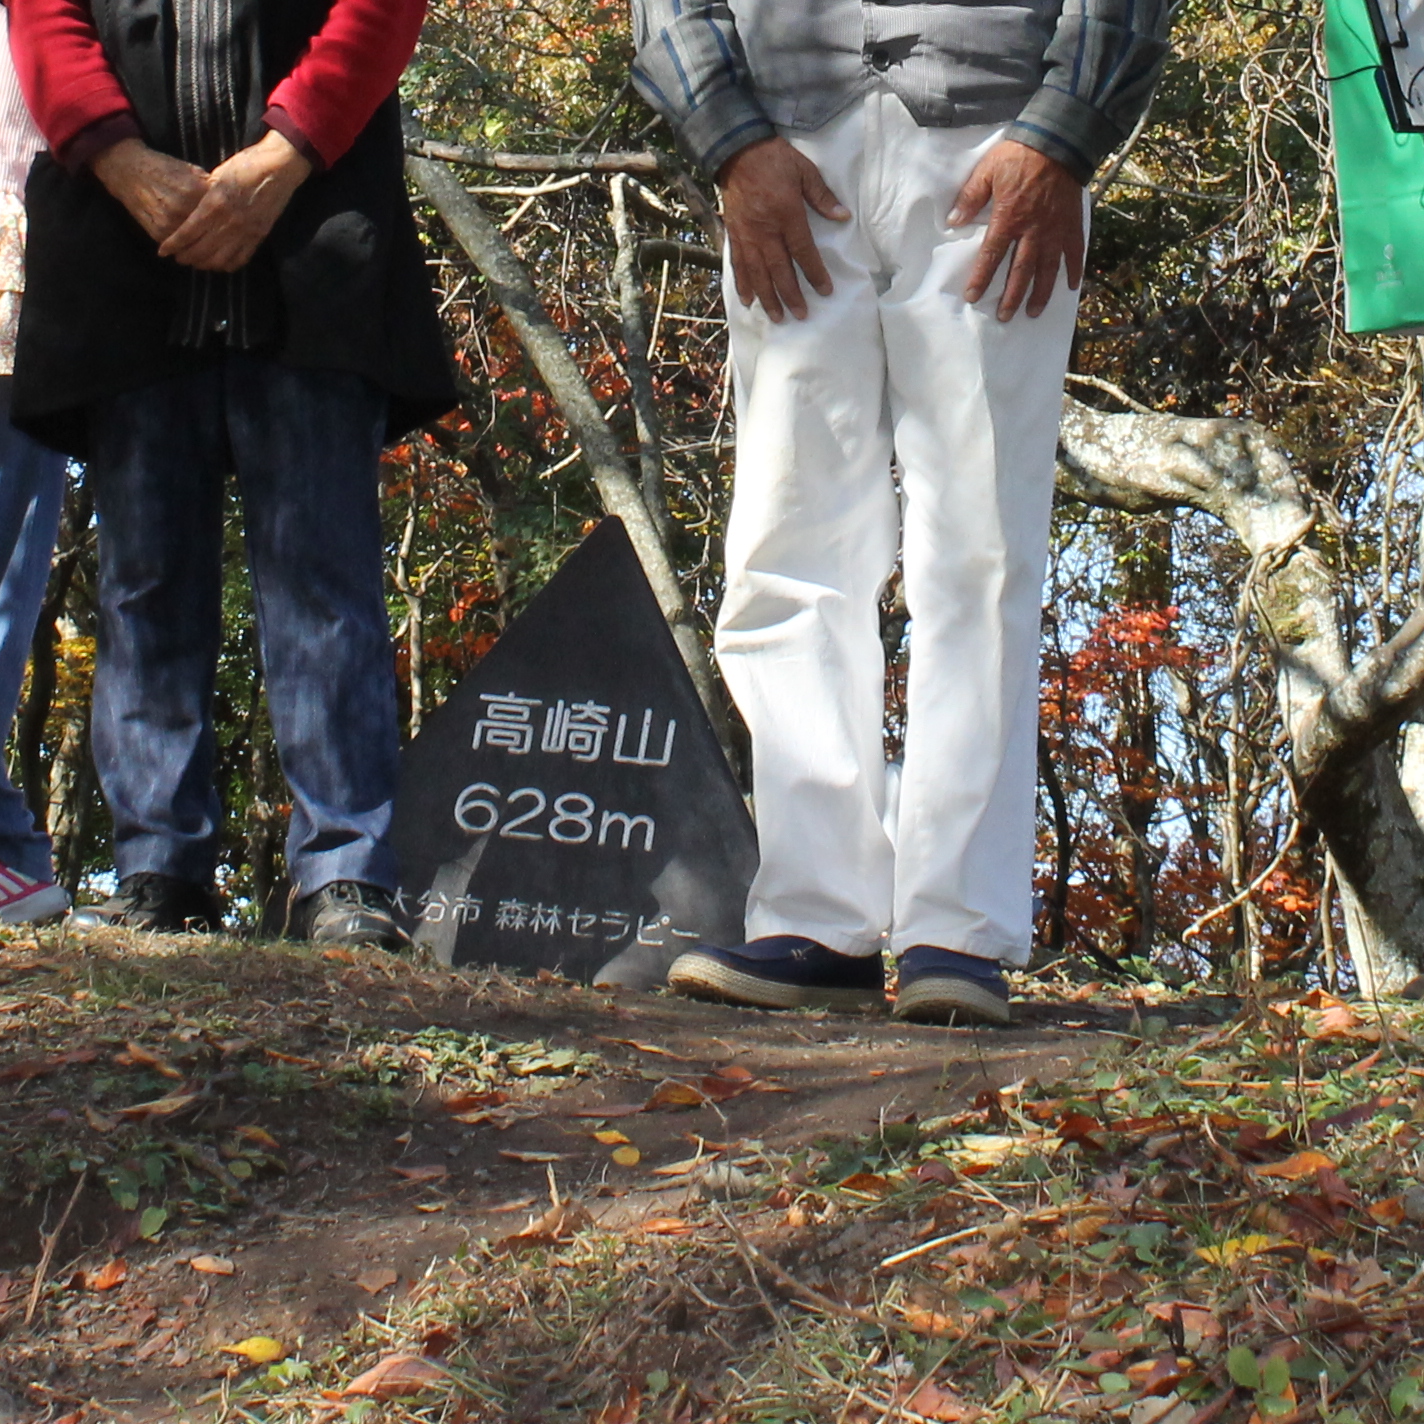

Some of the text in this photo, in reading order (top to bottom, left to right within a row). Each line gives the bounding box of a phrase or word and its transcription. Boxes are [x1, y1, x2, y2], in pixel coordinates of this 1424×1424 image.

[471, 691, 676, 766] 高崎山
[454, 782, 655, 852] 628m
[494, 897, 701, 946] 森林セラピー
